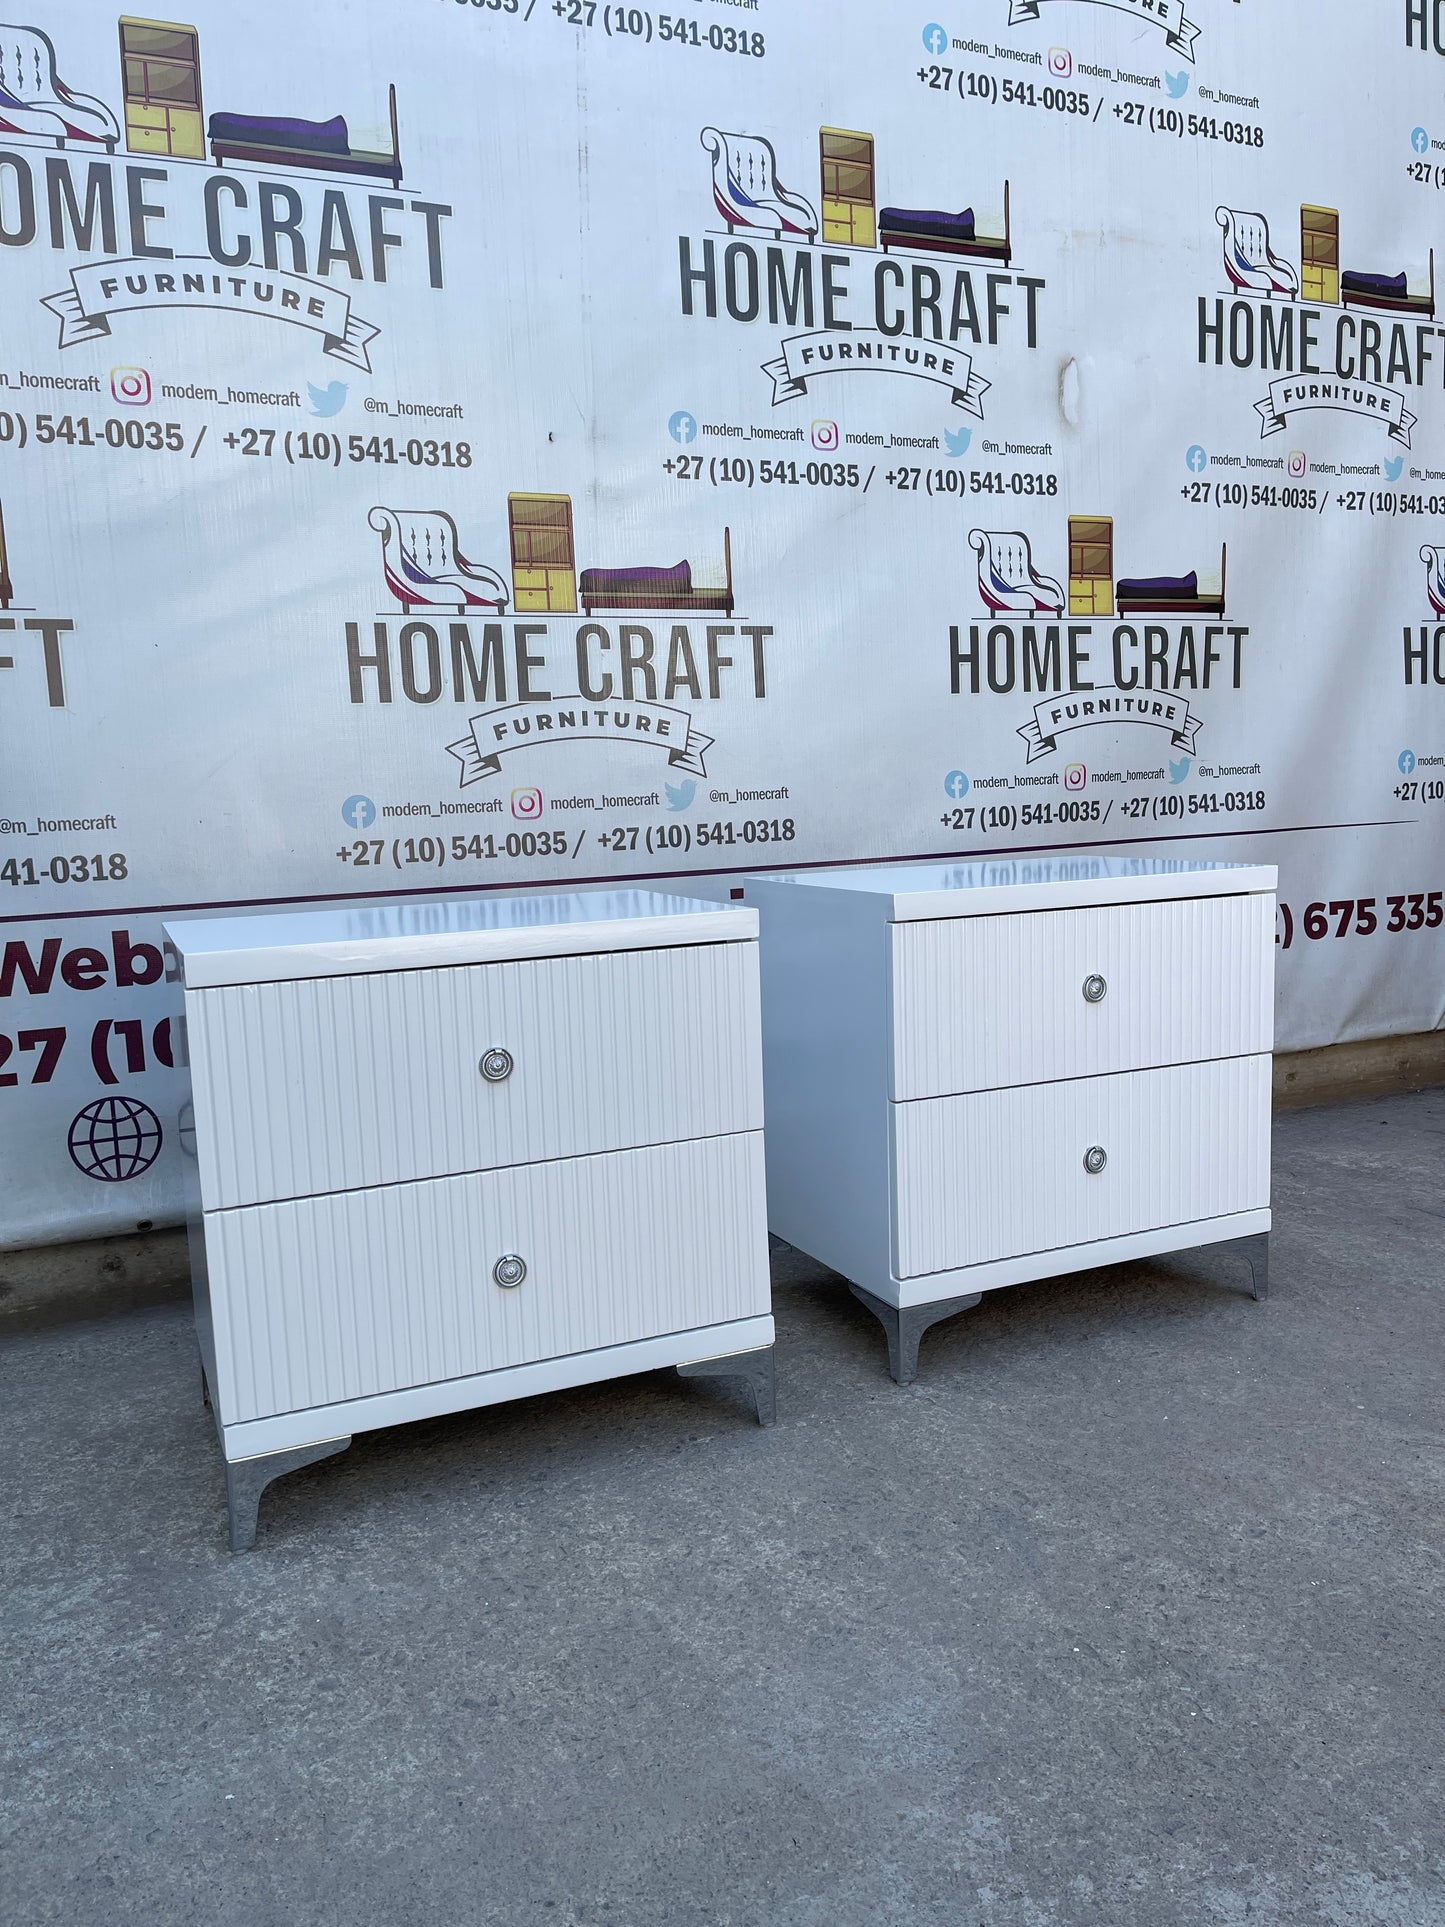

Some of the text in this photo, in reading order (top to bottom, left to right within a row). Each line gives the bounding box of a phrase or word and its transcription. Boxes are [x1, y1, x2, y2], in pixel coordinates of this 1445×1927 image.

[552, 0, 597, 27] +27
[604, 5, 651, 43] (10)
[658, 14, 766, 58] 541-0318
[917, 65, 1264, 148] +27 (10) 541-0035 / +27 (10) 541-0318
[1199, 85, 1260, 109] @m_homecraft
[1407, 162, 1431, 183] +27
[204, 175, 453, 289] CRAFT
[100, 274, 325, 319] FURNITURE
[679, 236, 1045, 348] HOME CRAFT
[1198, 296, 1320, 375] HOME
[801, 343, 955, 375] FURNITURE
[364, 397, 464, 419] @m_homecraft
[1283, 384, 1391, 413] FURNITURE
[35, 414, 184, 450] 541-0035
[190, 425, 208, 458] /
[223, 428, 276, 456] +27
[284, 431, 342, 467] (10)
[348, 435, 472, 468] 541-0318
[982, 440, 1052, 455] @m_homecraft
[663, 455, 1058, 497] +27 (10) 541-0035 / +27 (10) 541-0318
[1180, 482, 1211, 506] +27
[1215, 483, 1248, 509] (10)
[1251, 485, 1317, 509] 541-0035
[1318, 491, 1329, 514] /
[1336, 491, 1366, 511] +27
[1369, 492, 1397, 517] (10)
[345, 622, 774, 703] HOME CRAFT
[949, 625, 1249, 694] HOME CRAFT
[493, 709, 671, 741] FURNITURE
[1050, 699, 1176, 724] FURNITURE
[1199, 763, 1261, 778] @m_homecraft
[709, 786, 789, 805] @m_homecraft
[1394, 782, 1418, 800] +27
[0, 815, 117, 835] @m_homecraft
[940, 790, 1266, 833] +27 (10) 541-0035 / +27 (10) 541-0318
[336, 818, 796, 869] +27 (10) 541-0035 / +27 (10) 541-0318
[1, 853, 128, 886] 41-0318
[1303, 898, 1377, 940] 675
[1386, 892, 1444, 932] 335
